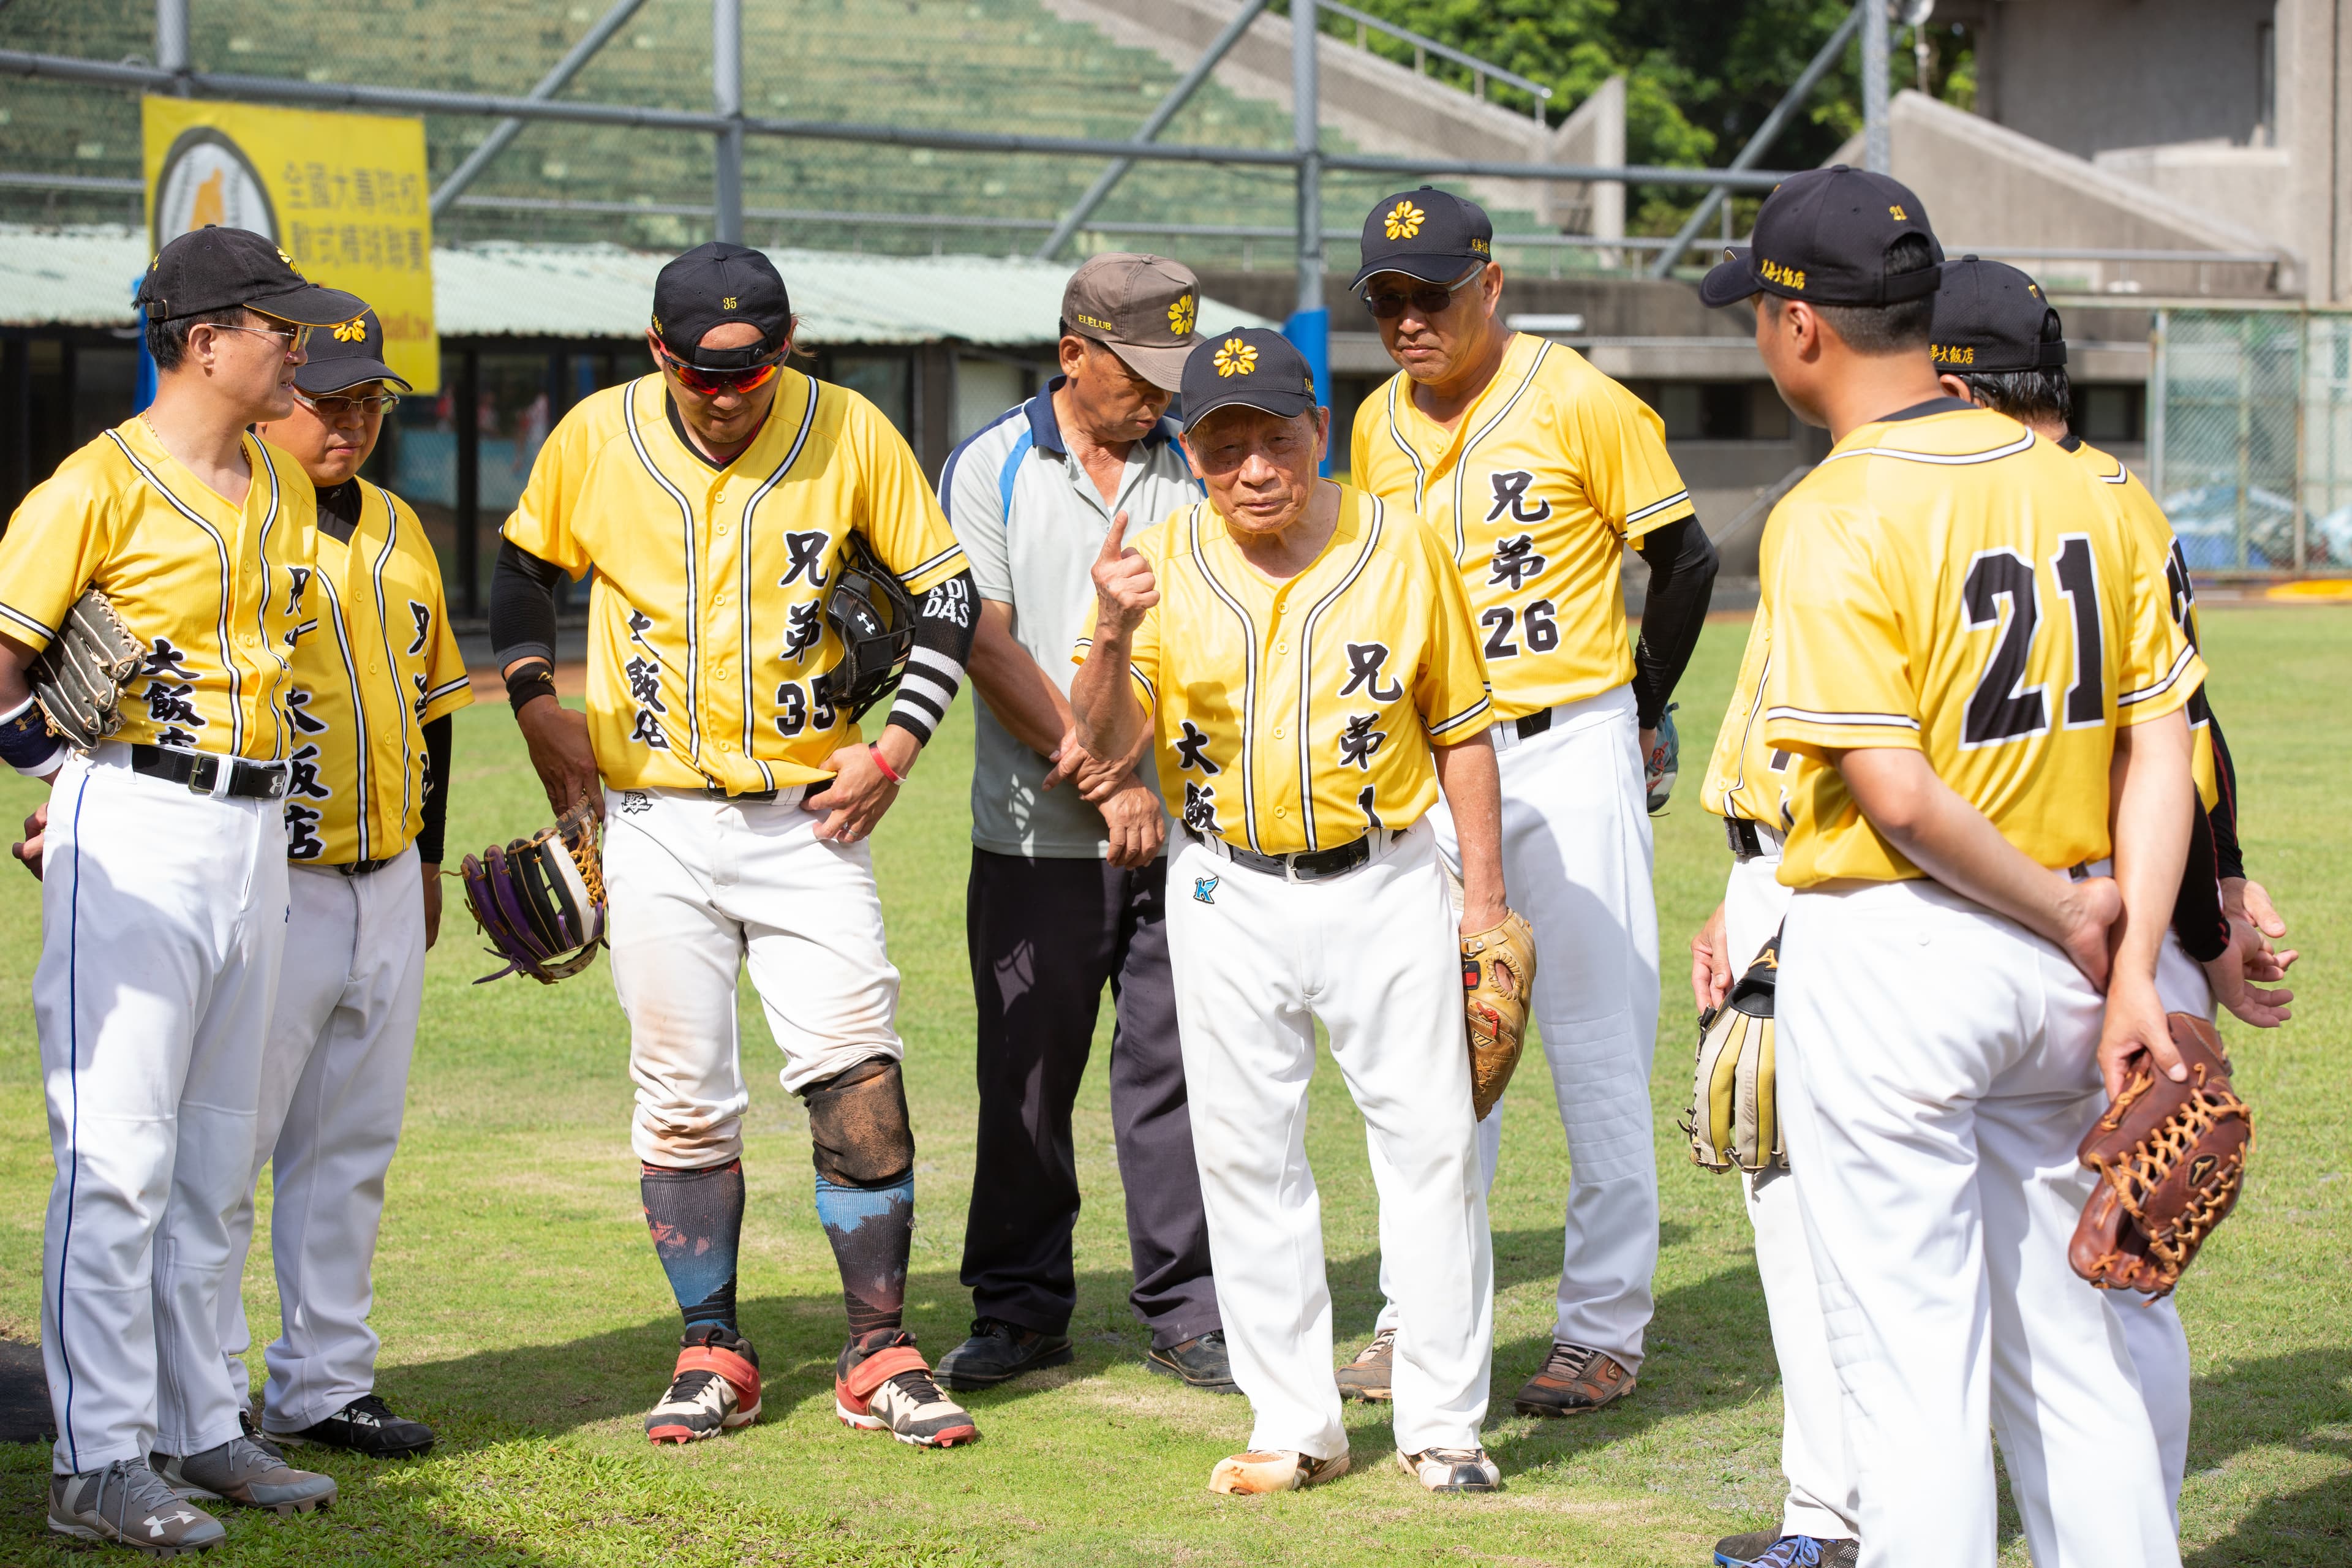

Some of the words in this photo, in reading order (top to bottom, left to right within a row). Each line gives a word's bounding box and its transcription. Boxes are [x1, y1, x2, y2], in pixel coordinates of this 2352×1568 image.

[1889, 205, 1907, 221] 21
[723, 296, 737, 310] 35
[1483, 469, 1552, 592] 兄弟
[778, 528, 832, 665] 兄弟
[922, 597, 970, 628] DAS
[929, 578, 968, 603] ADI
[1479, 598, 1561, 663] 26
[1959, 532, 2105, 751] 21
[774, 675, 839, 739] 35
[1338, 641, 1404, 772] 兄弟
